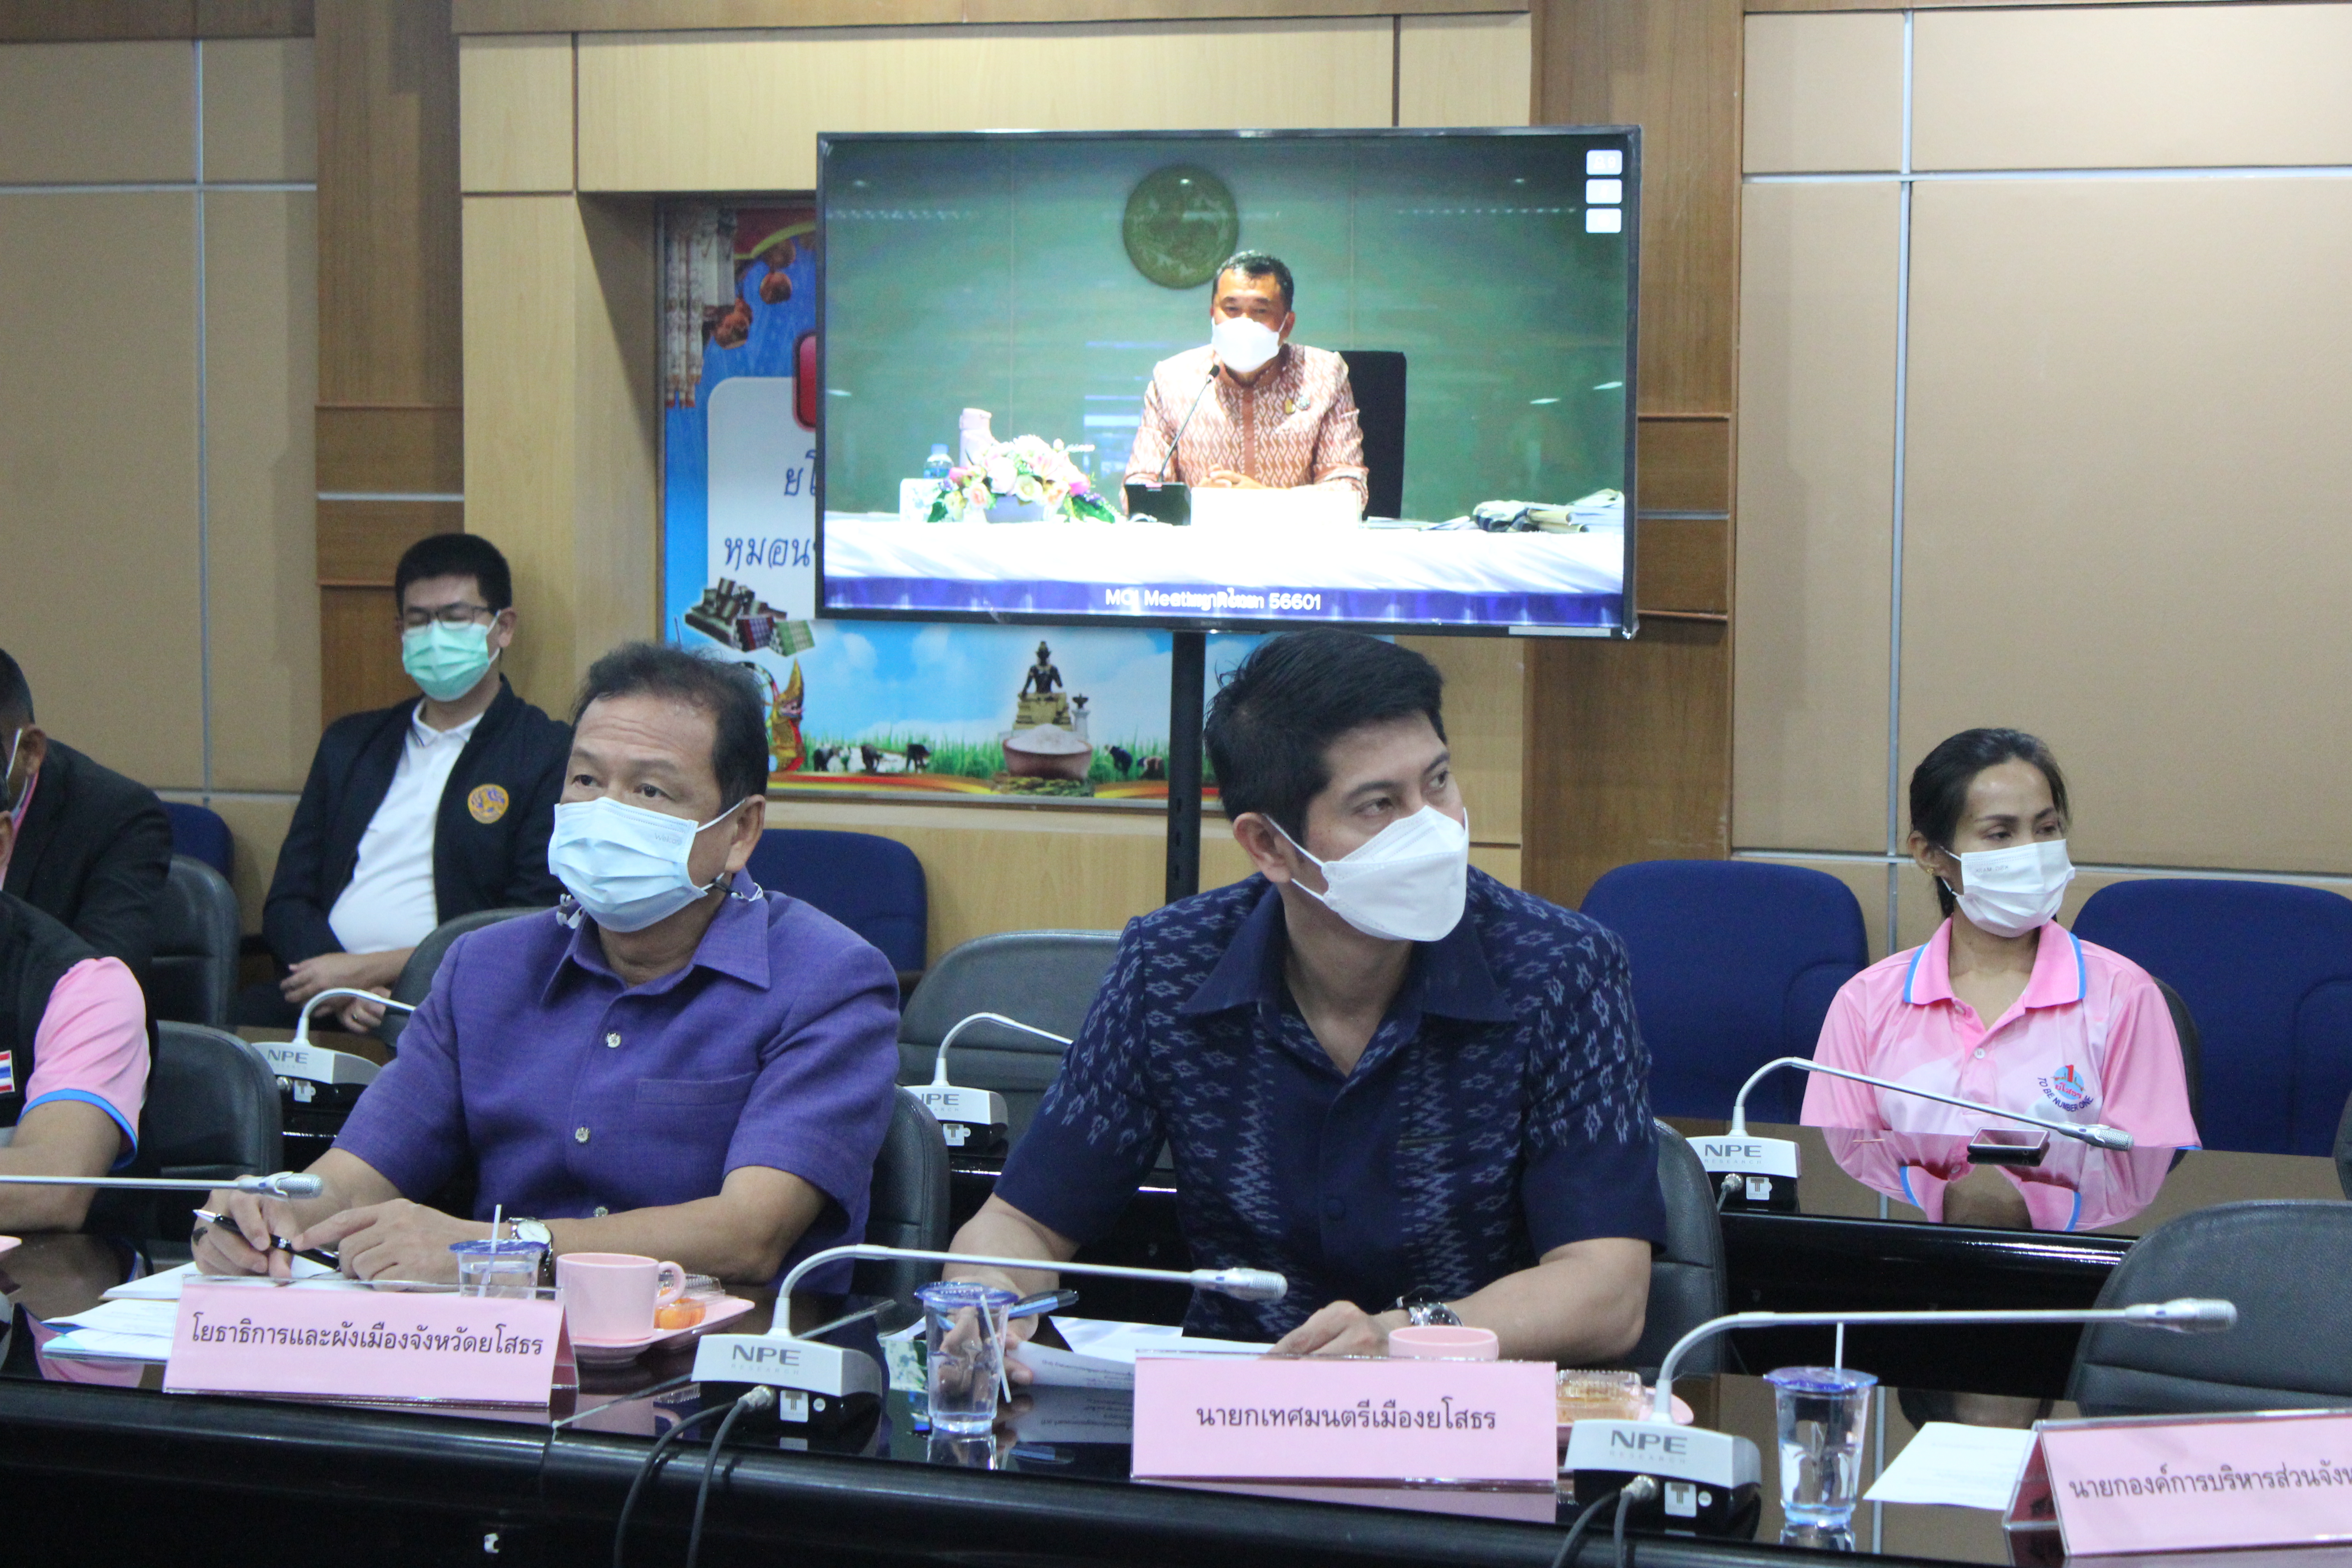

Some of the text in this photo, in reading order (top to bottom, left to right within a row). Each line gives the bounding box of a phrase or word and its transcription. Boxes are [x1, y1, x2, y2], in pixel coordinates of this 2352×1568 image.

[725, 536, 816, 572] หมอน
[1269, 592, 1321, 611] 56601
[268, 1049, 309, 1064] NPE
[2037, 1077, 2094, 1112] TO BE NUMBER ONE
[1705, 1144, 1762, 1157] NPE
[191, 1312, 543, 1357] โยธาธิการและผังเมืองจังหวัดยโสธร
[733, 1344, 801, 1366] NPE
[1196, 1396, 1497, 1430] นายกเทศมนตรีเมืองยโสธร
[1611, 1430, 1688, 1455] NPE
